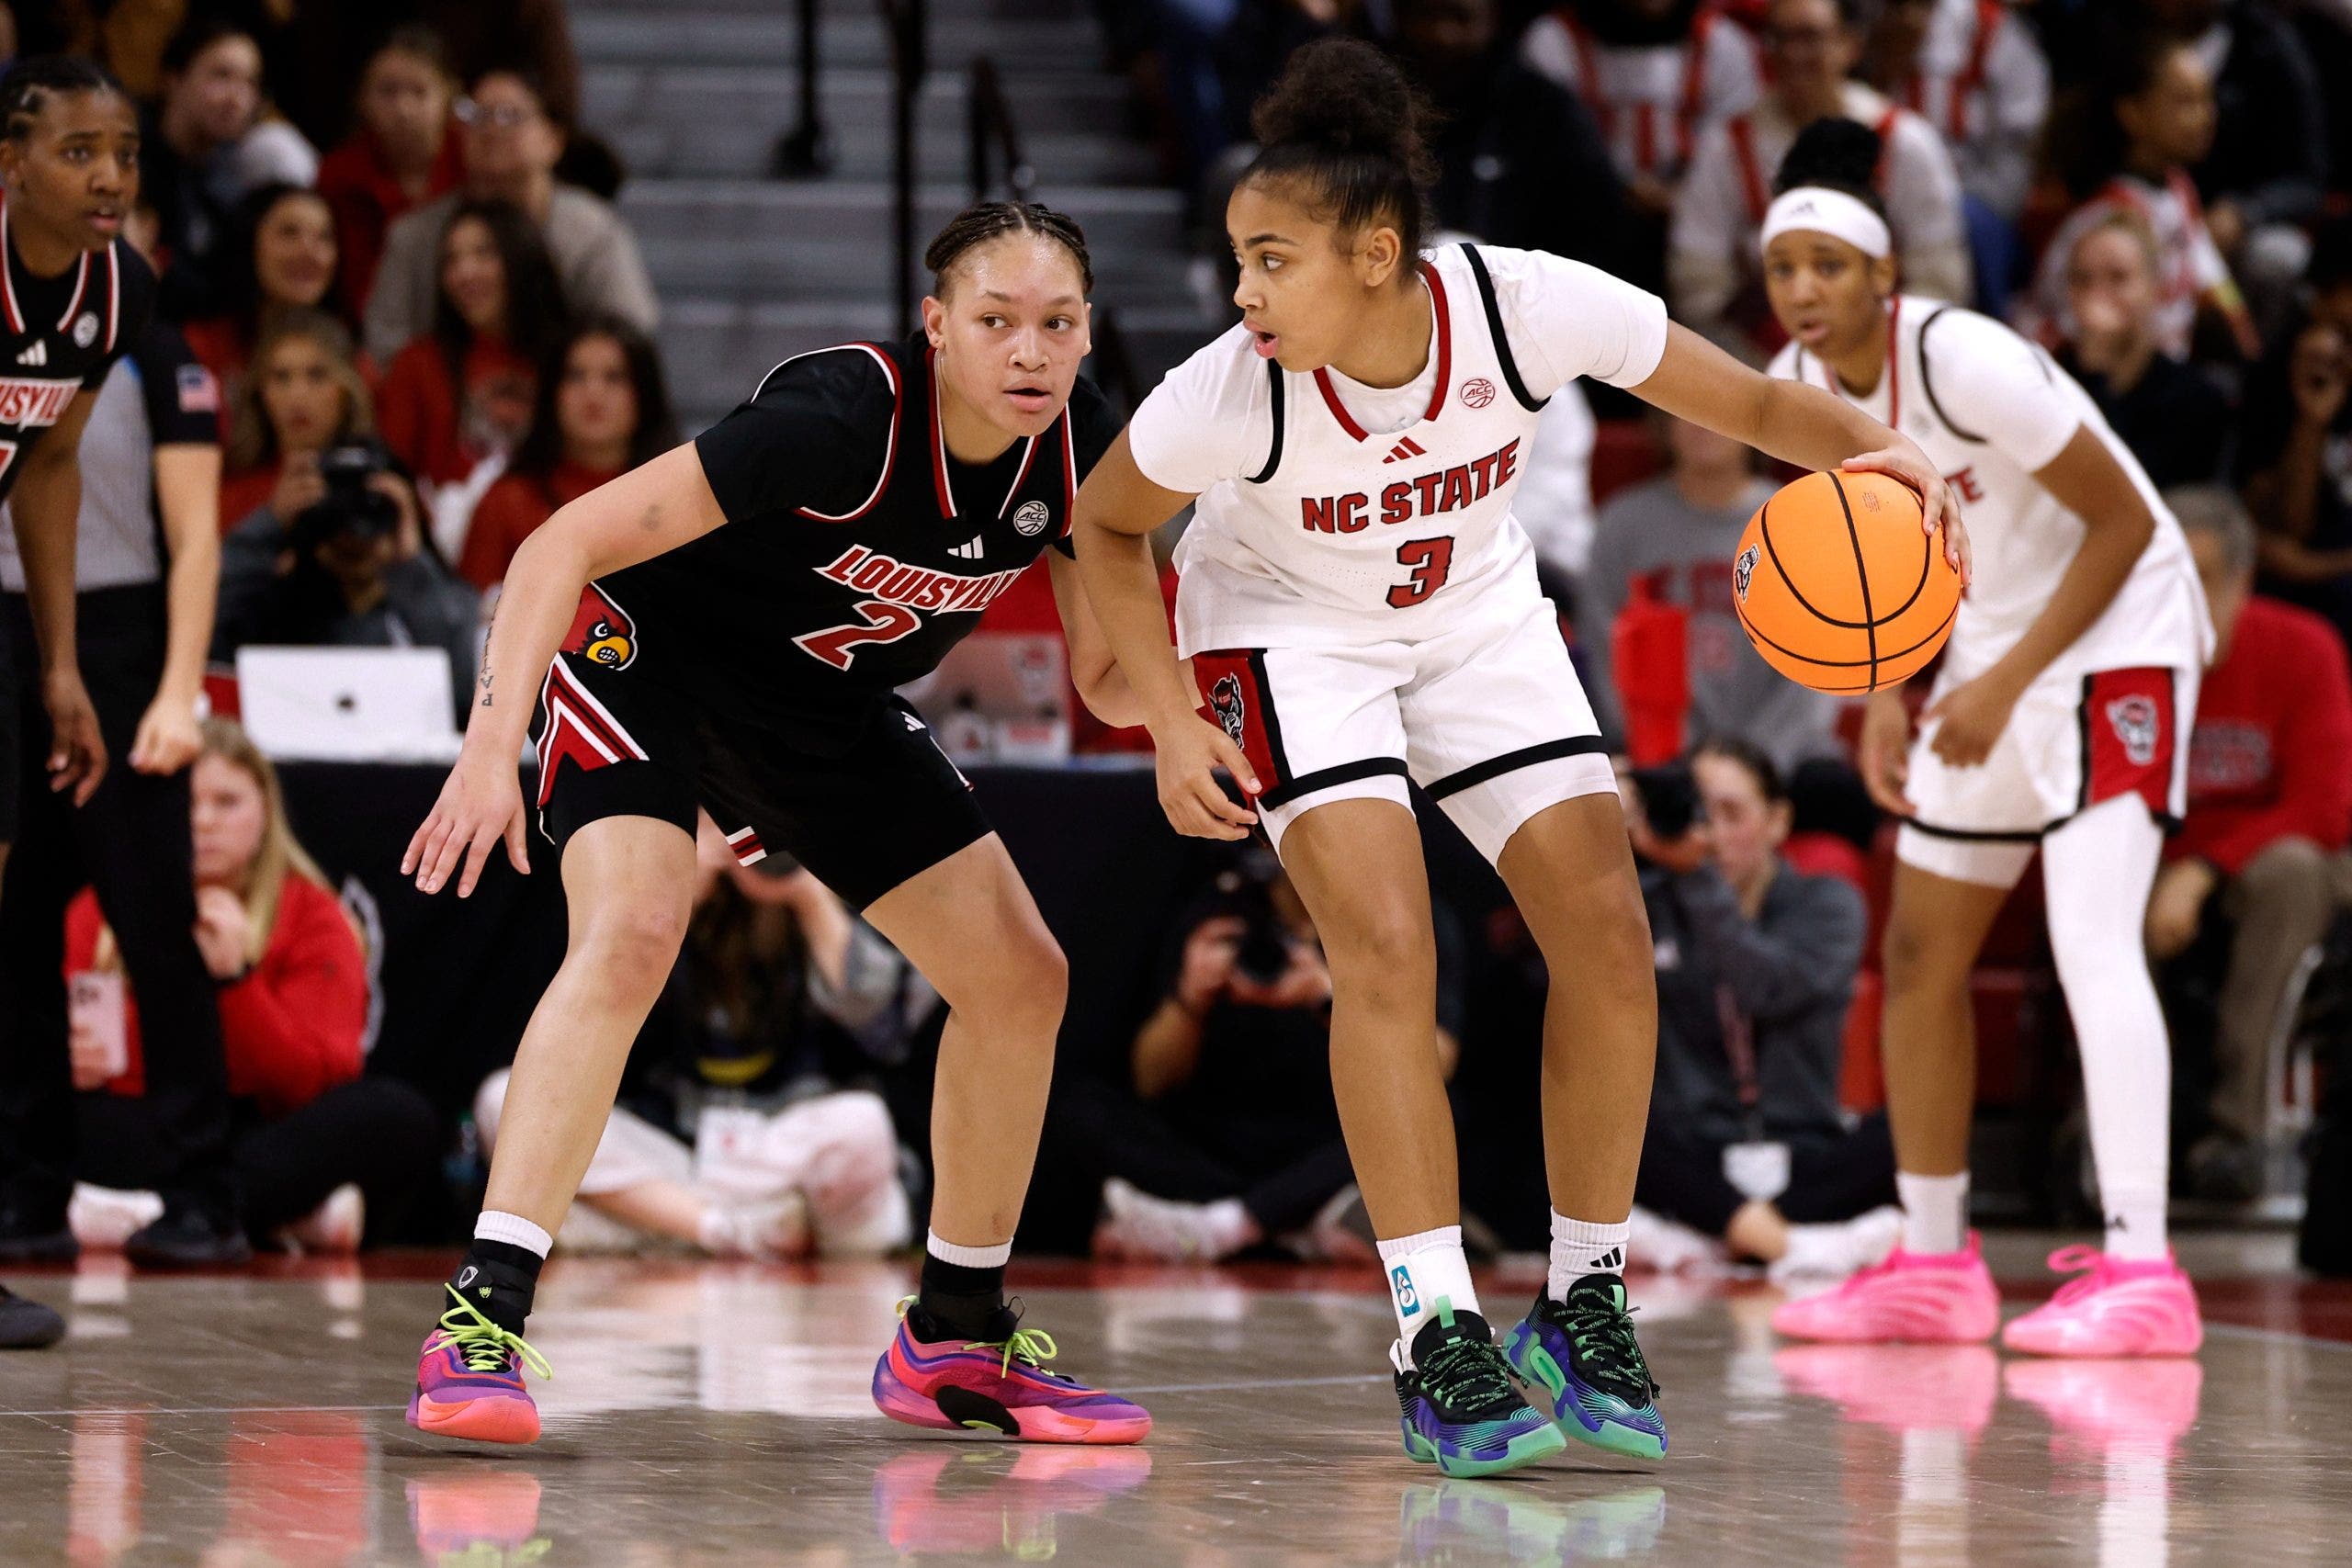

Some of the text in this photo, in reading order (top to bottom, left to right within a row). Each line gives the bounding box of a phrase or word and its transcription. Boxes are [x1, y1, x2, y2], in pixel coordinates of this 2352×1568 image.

[1301, 435, 1521, 534] NC STATE
[1385, 535, 1455, 609] 3
[790, 600, 922, 672] 2
